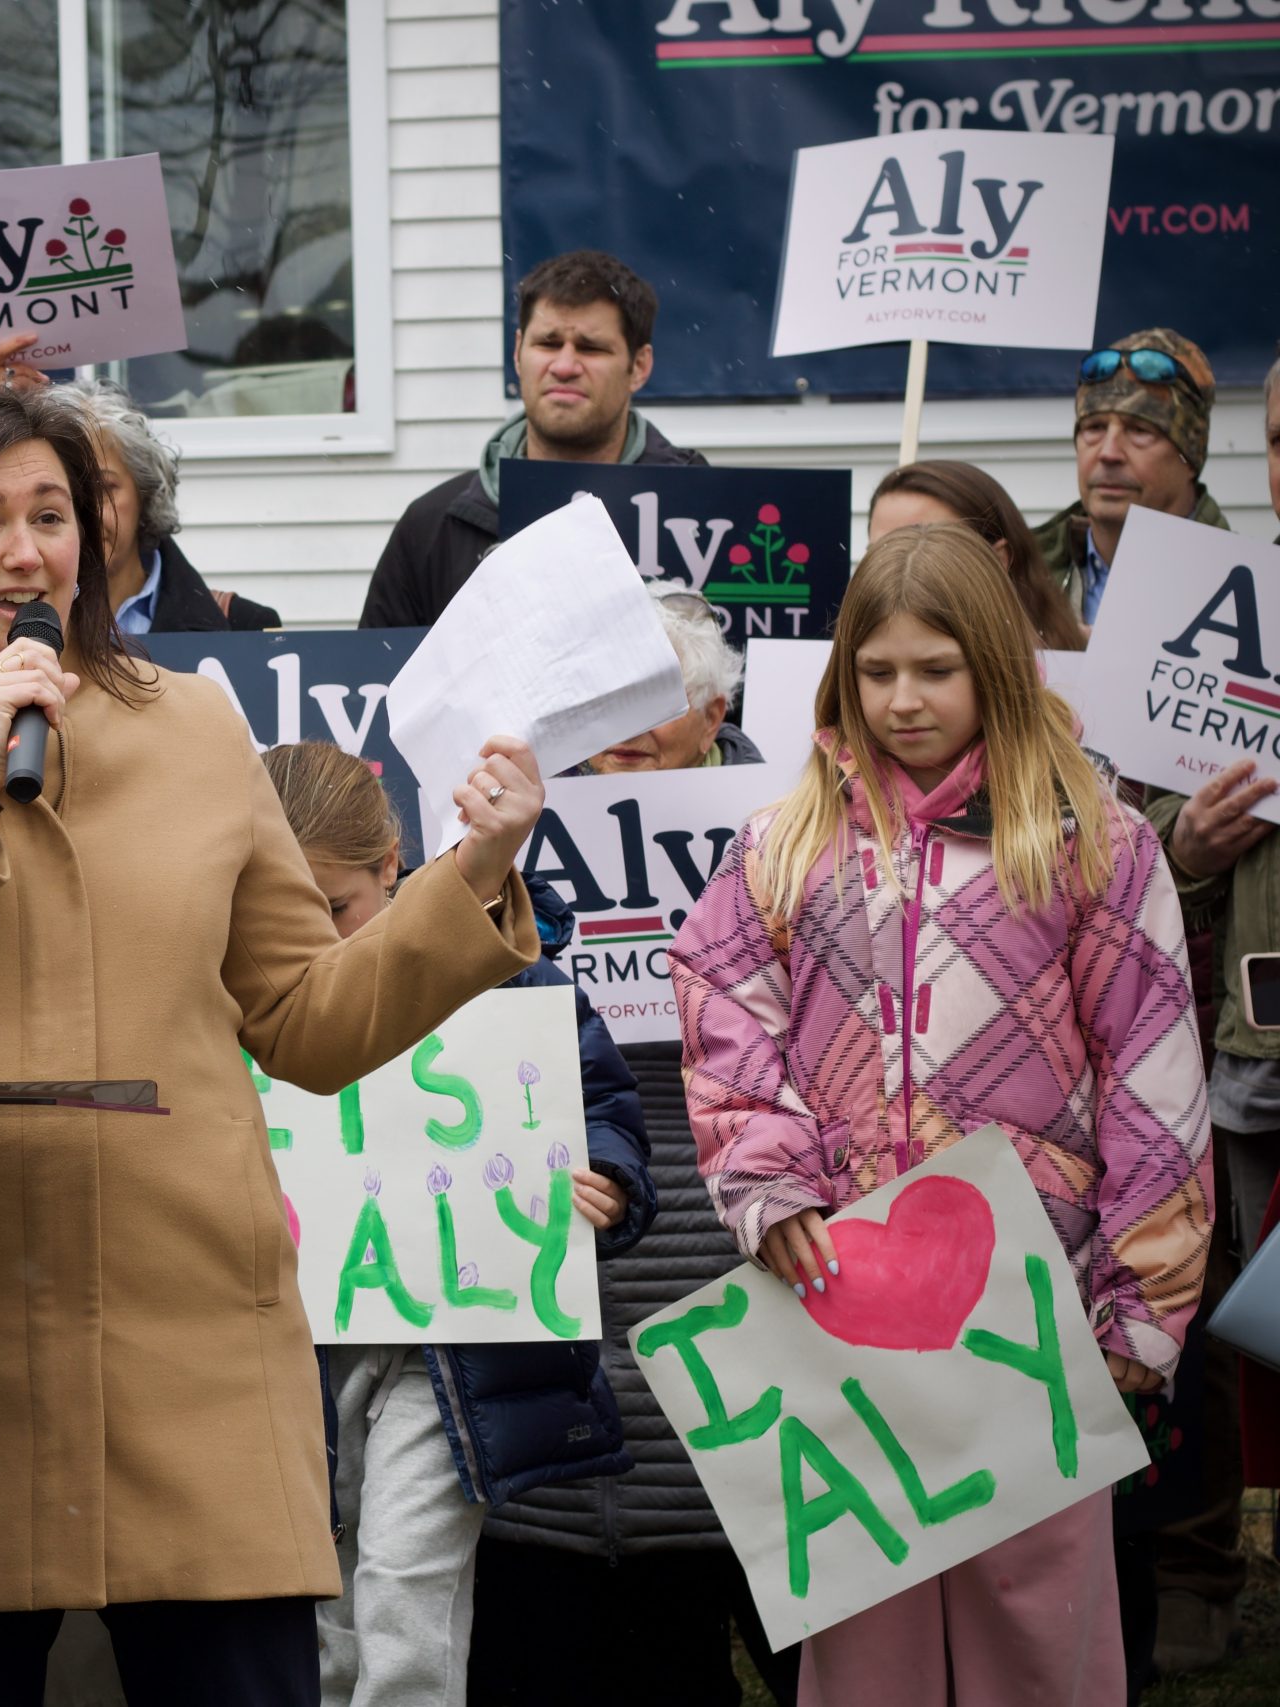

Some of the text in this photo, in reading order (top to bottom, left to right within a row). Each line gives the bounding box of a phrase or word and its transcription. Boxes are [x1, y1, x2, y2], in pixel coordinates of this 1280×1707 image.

[873, 80, 979, 136] for
[841, 149, 1045, 260] Aly
[836, 267, 1027, 300] VERMONT
[837, 245, 889, 270] FOR
[865, 307, 988, 325] ALYFORVT.COM
[1150, 660, 1219, 698] FOR
[522, 798, 736, 931] Aly
[334, 1167, 582, 1339] ALY
[636, 1283, 784, 1451] I
[778, 1251, 1079, 1600] ALY
